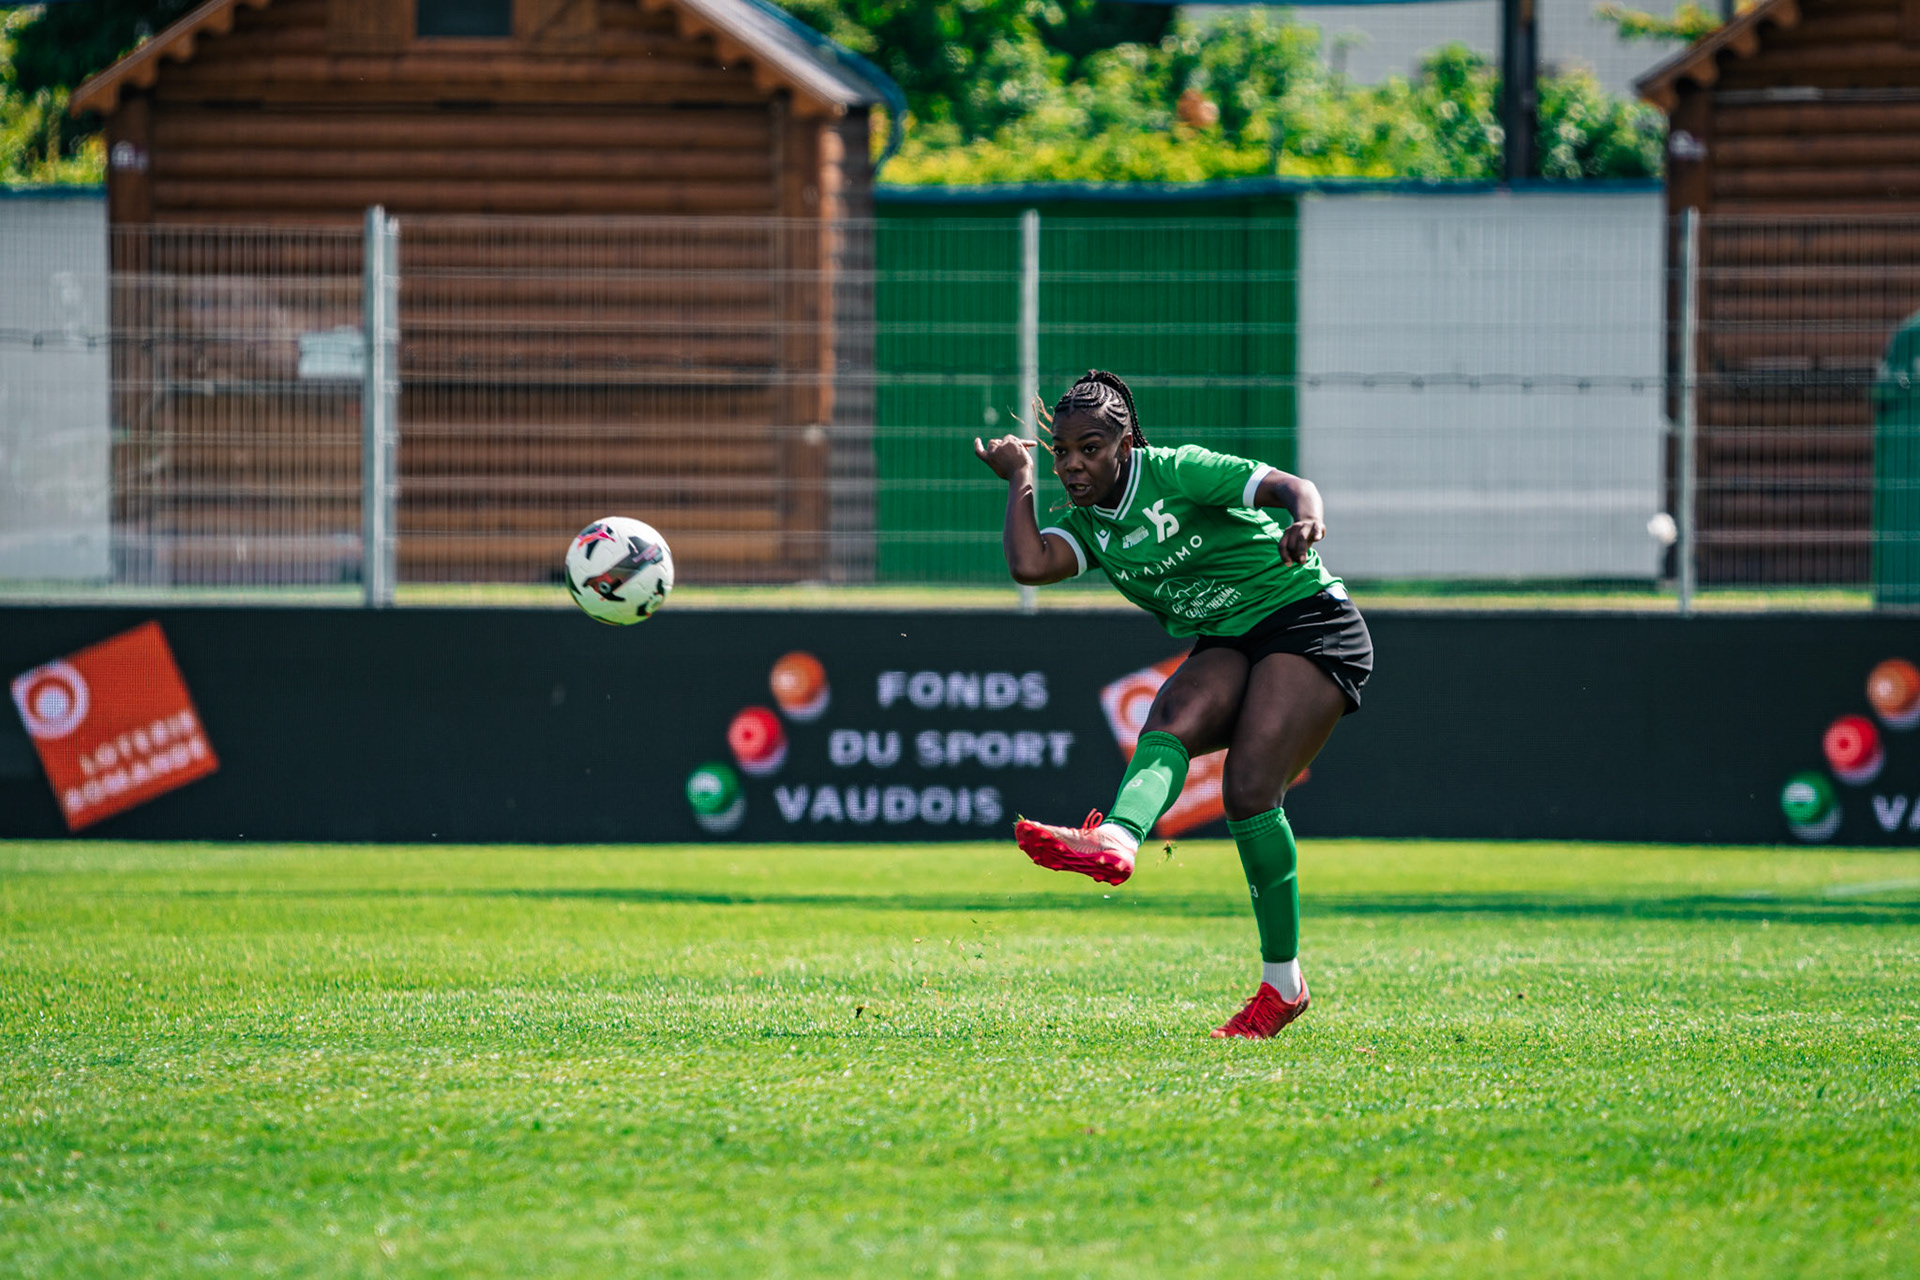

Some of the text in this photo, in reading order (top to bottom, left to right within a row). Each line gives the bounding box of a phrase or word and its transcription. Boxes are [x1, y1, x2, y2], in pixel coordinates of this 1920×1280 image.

[877, 671, 1048, 709] FONDS
[829, 729, 1074, 768] DU SPORT
[774, 785, 1003, 825] VAUDOIS
